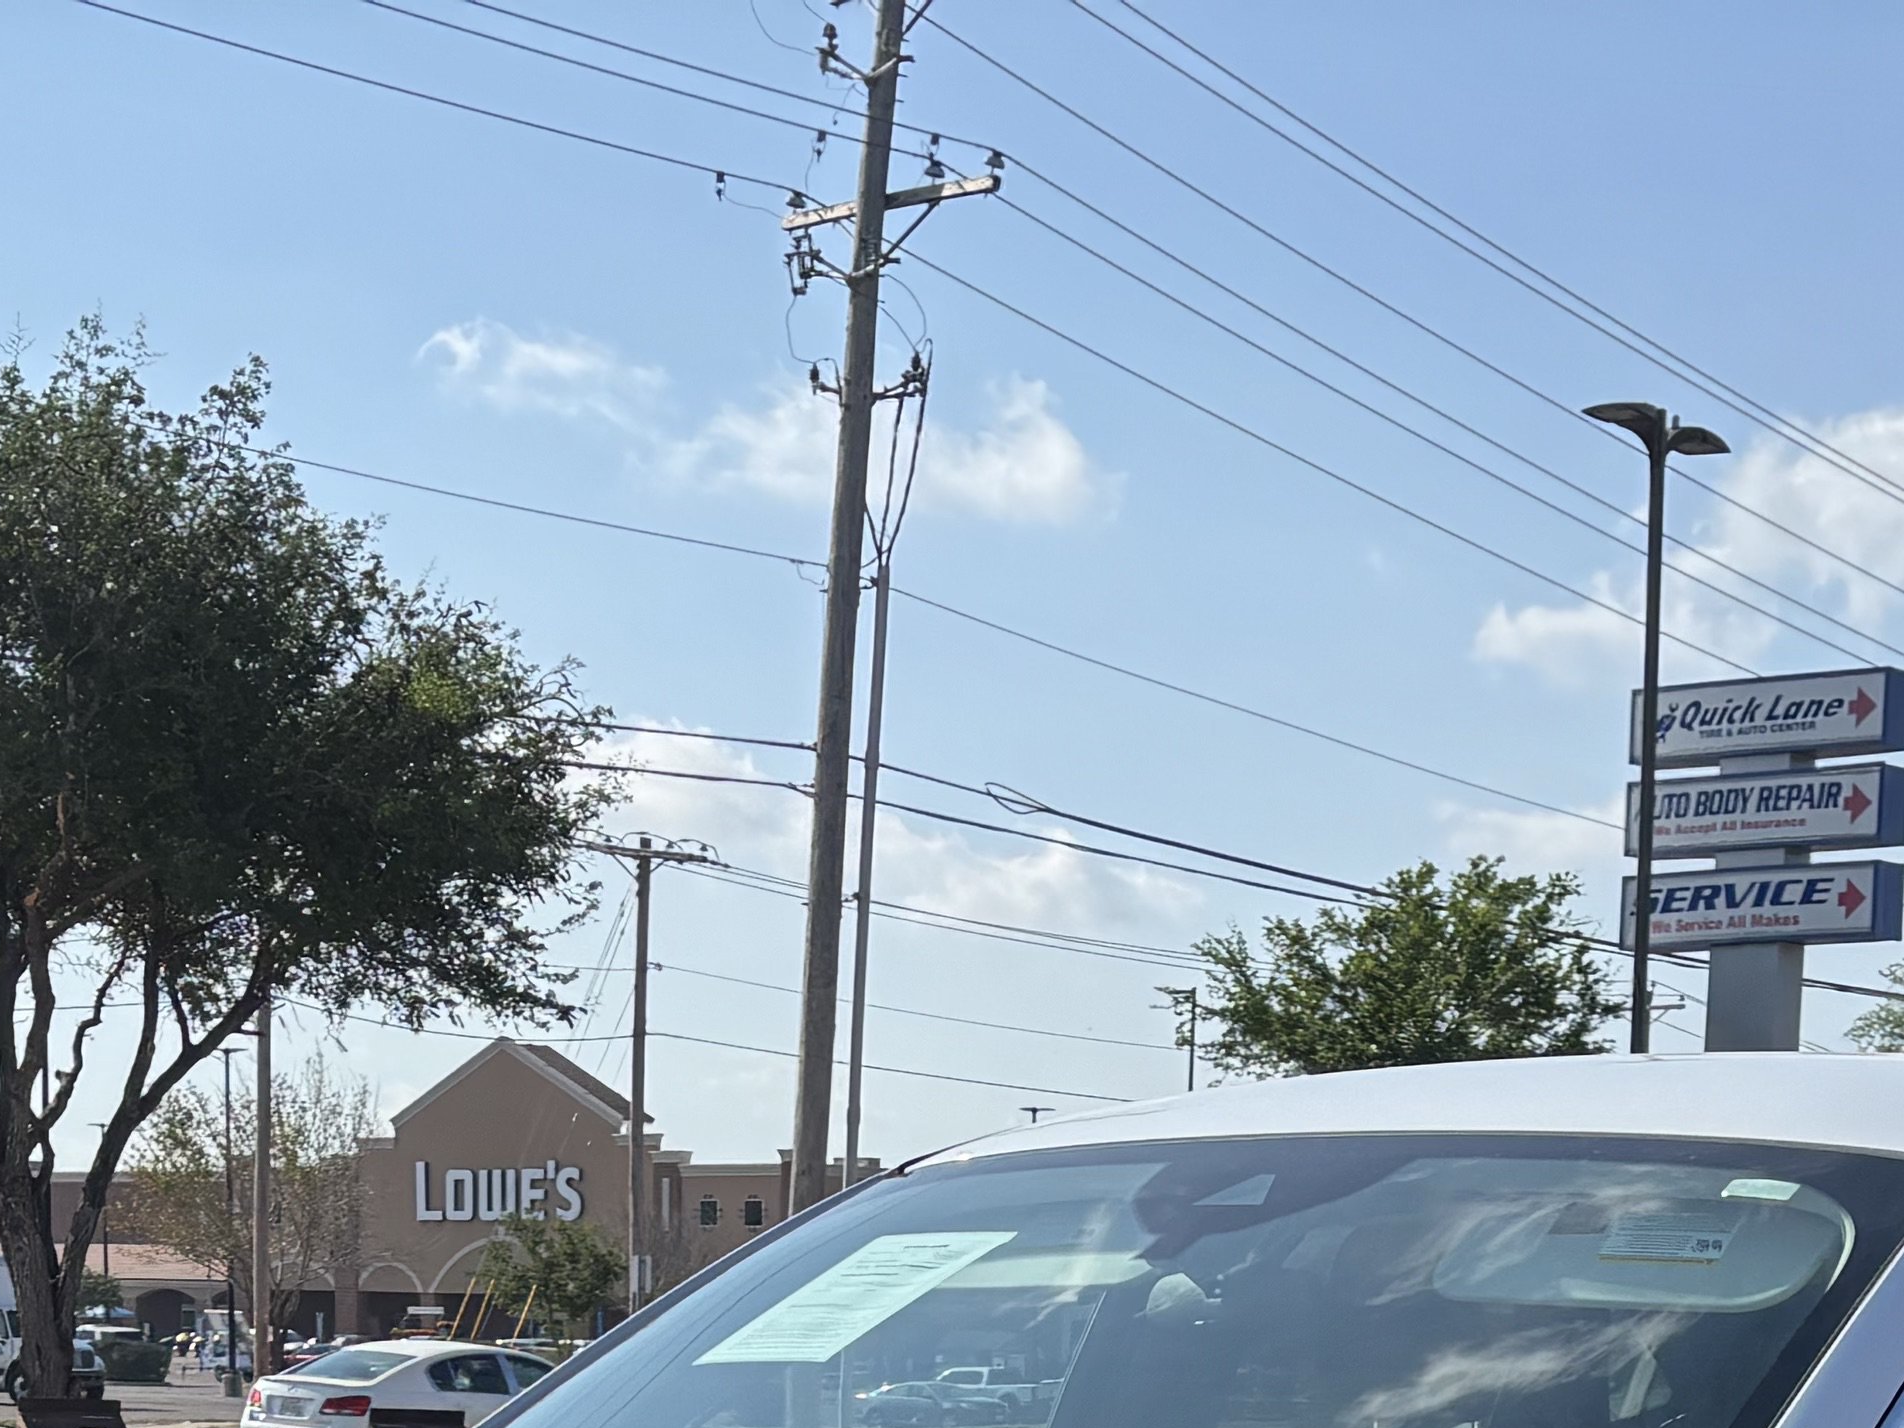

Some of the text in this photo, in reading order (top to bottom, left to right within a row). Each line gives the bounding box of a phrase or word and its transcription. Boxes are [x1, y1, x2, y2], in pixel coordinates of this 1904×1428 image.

[1680, 694, 1845, 731] Quick Lane
[1699, 729, 1723, 739] TIRE
[1737, 724, 1768, 736] AUTO
[1770, 721, 1817, 734] CENTER
[1637, 782, 1842, 820] UTO BODY REPAIR
[1651, 914, 1800, 934] We Service All Makes
[415, 1159, 583, 1222] LOWE'S
